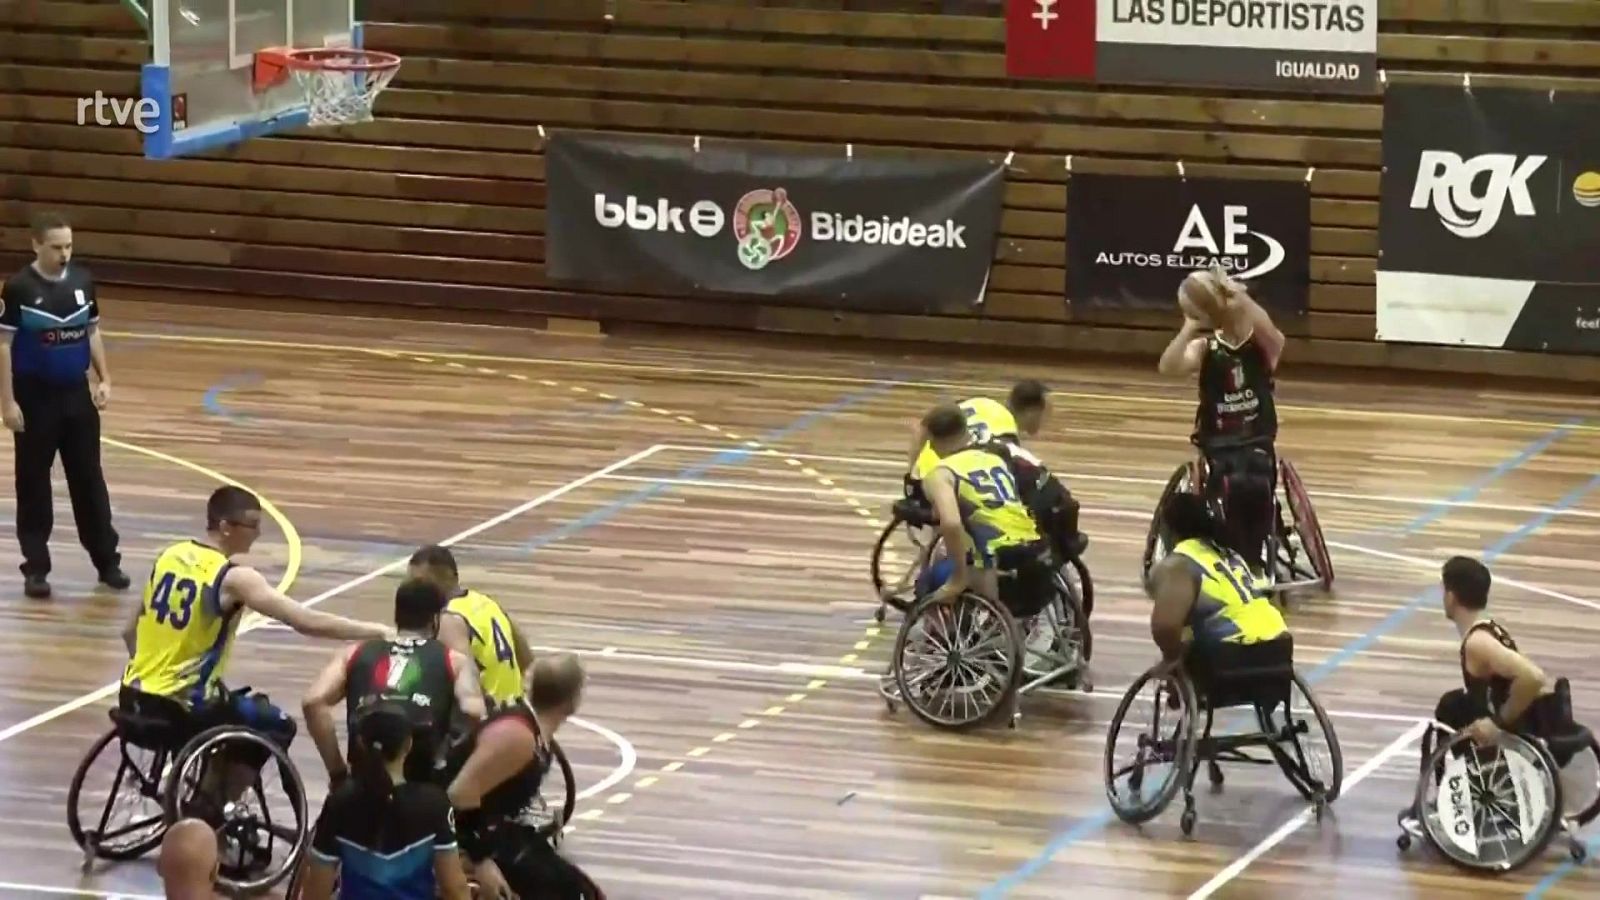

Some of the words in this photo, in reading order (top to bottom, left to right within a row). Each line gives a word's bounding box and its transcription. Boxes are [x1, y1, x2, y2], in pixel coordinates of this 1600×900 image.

[1112, 0, 1165, 24] LAS
[1171, 0, 1365, 33] DEPORTISTAS
[1275, 60, 1360, 80] IGUALDAD
[594, 193, 685, 234] bbk
[811, 211, 966, 249] Bidaideak
[1173, 203, 1249, 255] AE
[1095, 251, 1163, 267] AUTOS
[1166, 253, 1249, 271] ELIZASU
[966, 466, 1018, 509] 50
[150, 571, 198, 631] 43
[490, 617, 516, 670] 4
